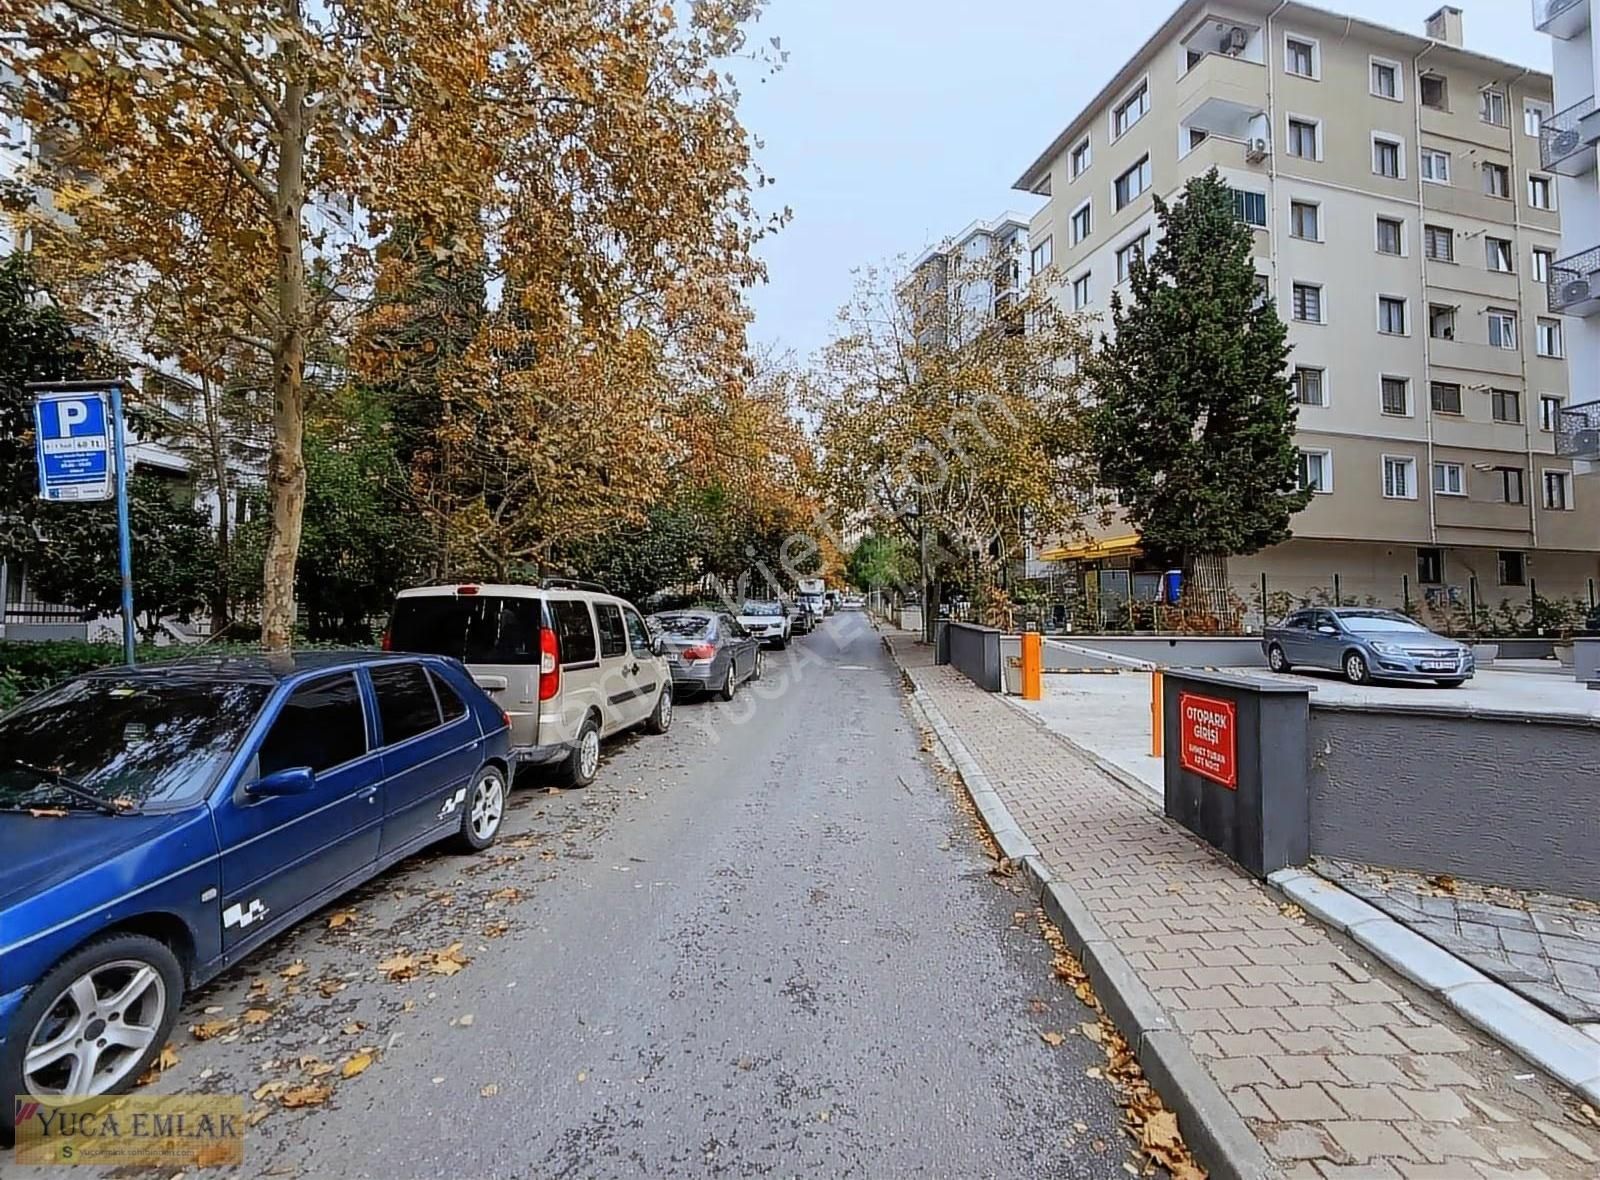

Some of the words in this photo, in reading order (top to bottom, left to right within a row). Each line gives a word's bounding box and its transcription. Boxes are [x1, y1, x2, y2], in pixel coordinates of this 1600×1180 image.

[57, 400, 87, 438] P
[1186, 706, 1227, 729] OTOPARK
[1193, 722, 1219, 746] GİRİŞİ
